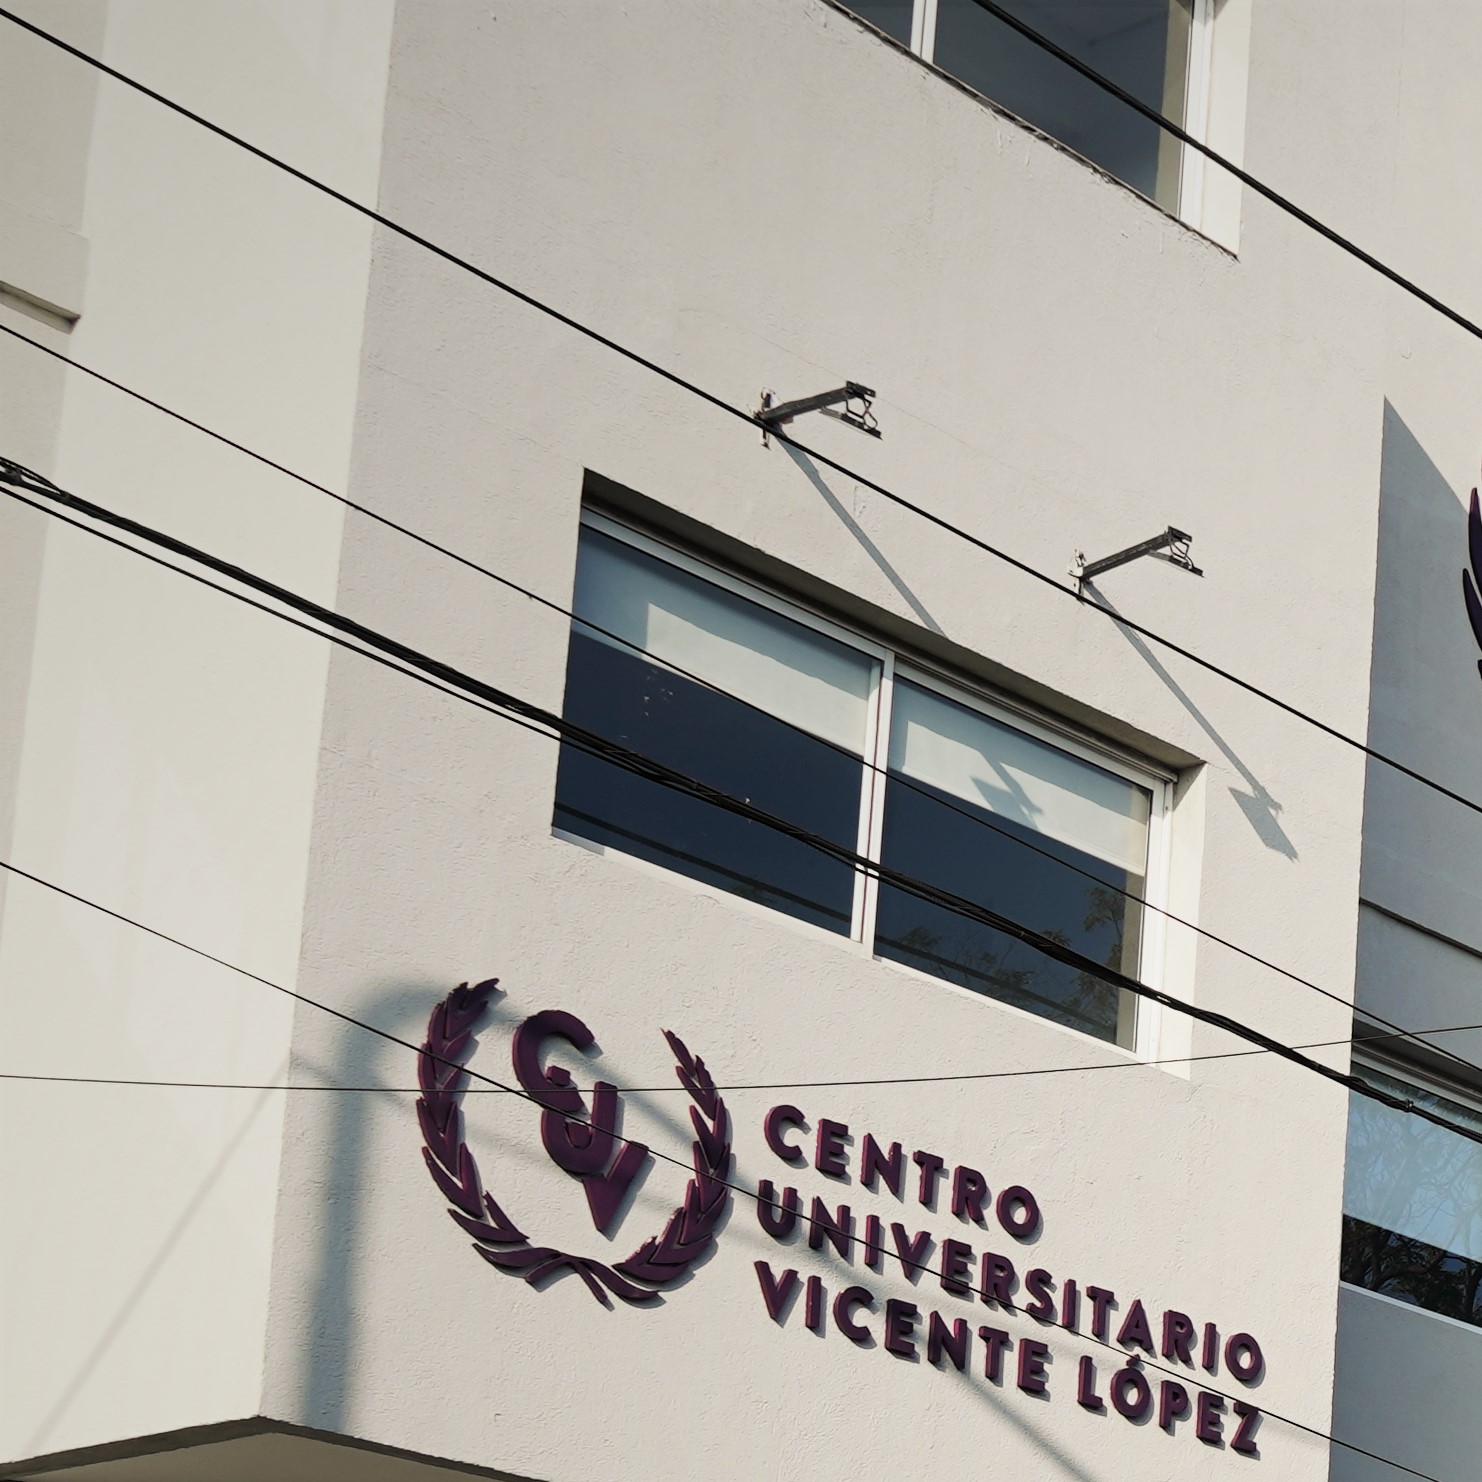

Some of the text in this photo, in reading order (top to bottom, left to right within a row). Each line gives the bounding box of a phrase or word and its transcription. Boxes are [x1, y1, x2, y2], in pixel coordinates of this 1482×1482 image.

[764, 1103, 1044, 1241] CENTRO
[754, 1260, 1260, 1457] VICENTE LÓPEZ
[756, 1178, 1267, 1383] UNIVERSITARIO
